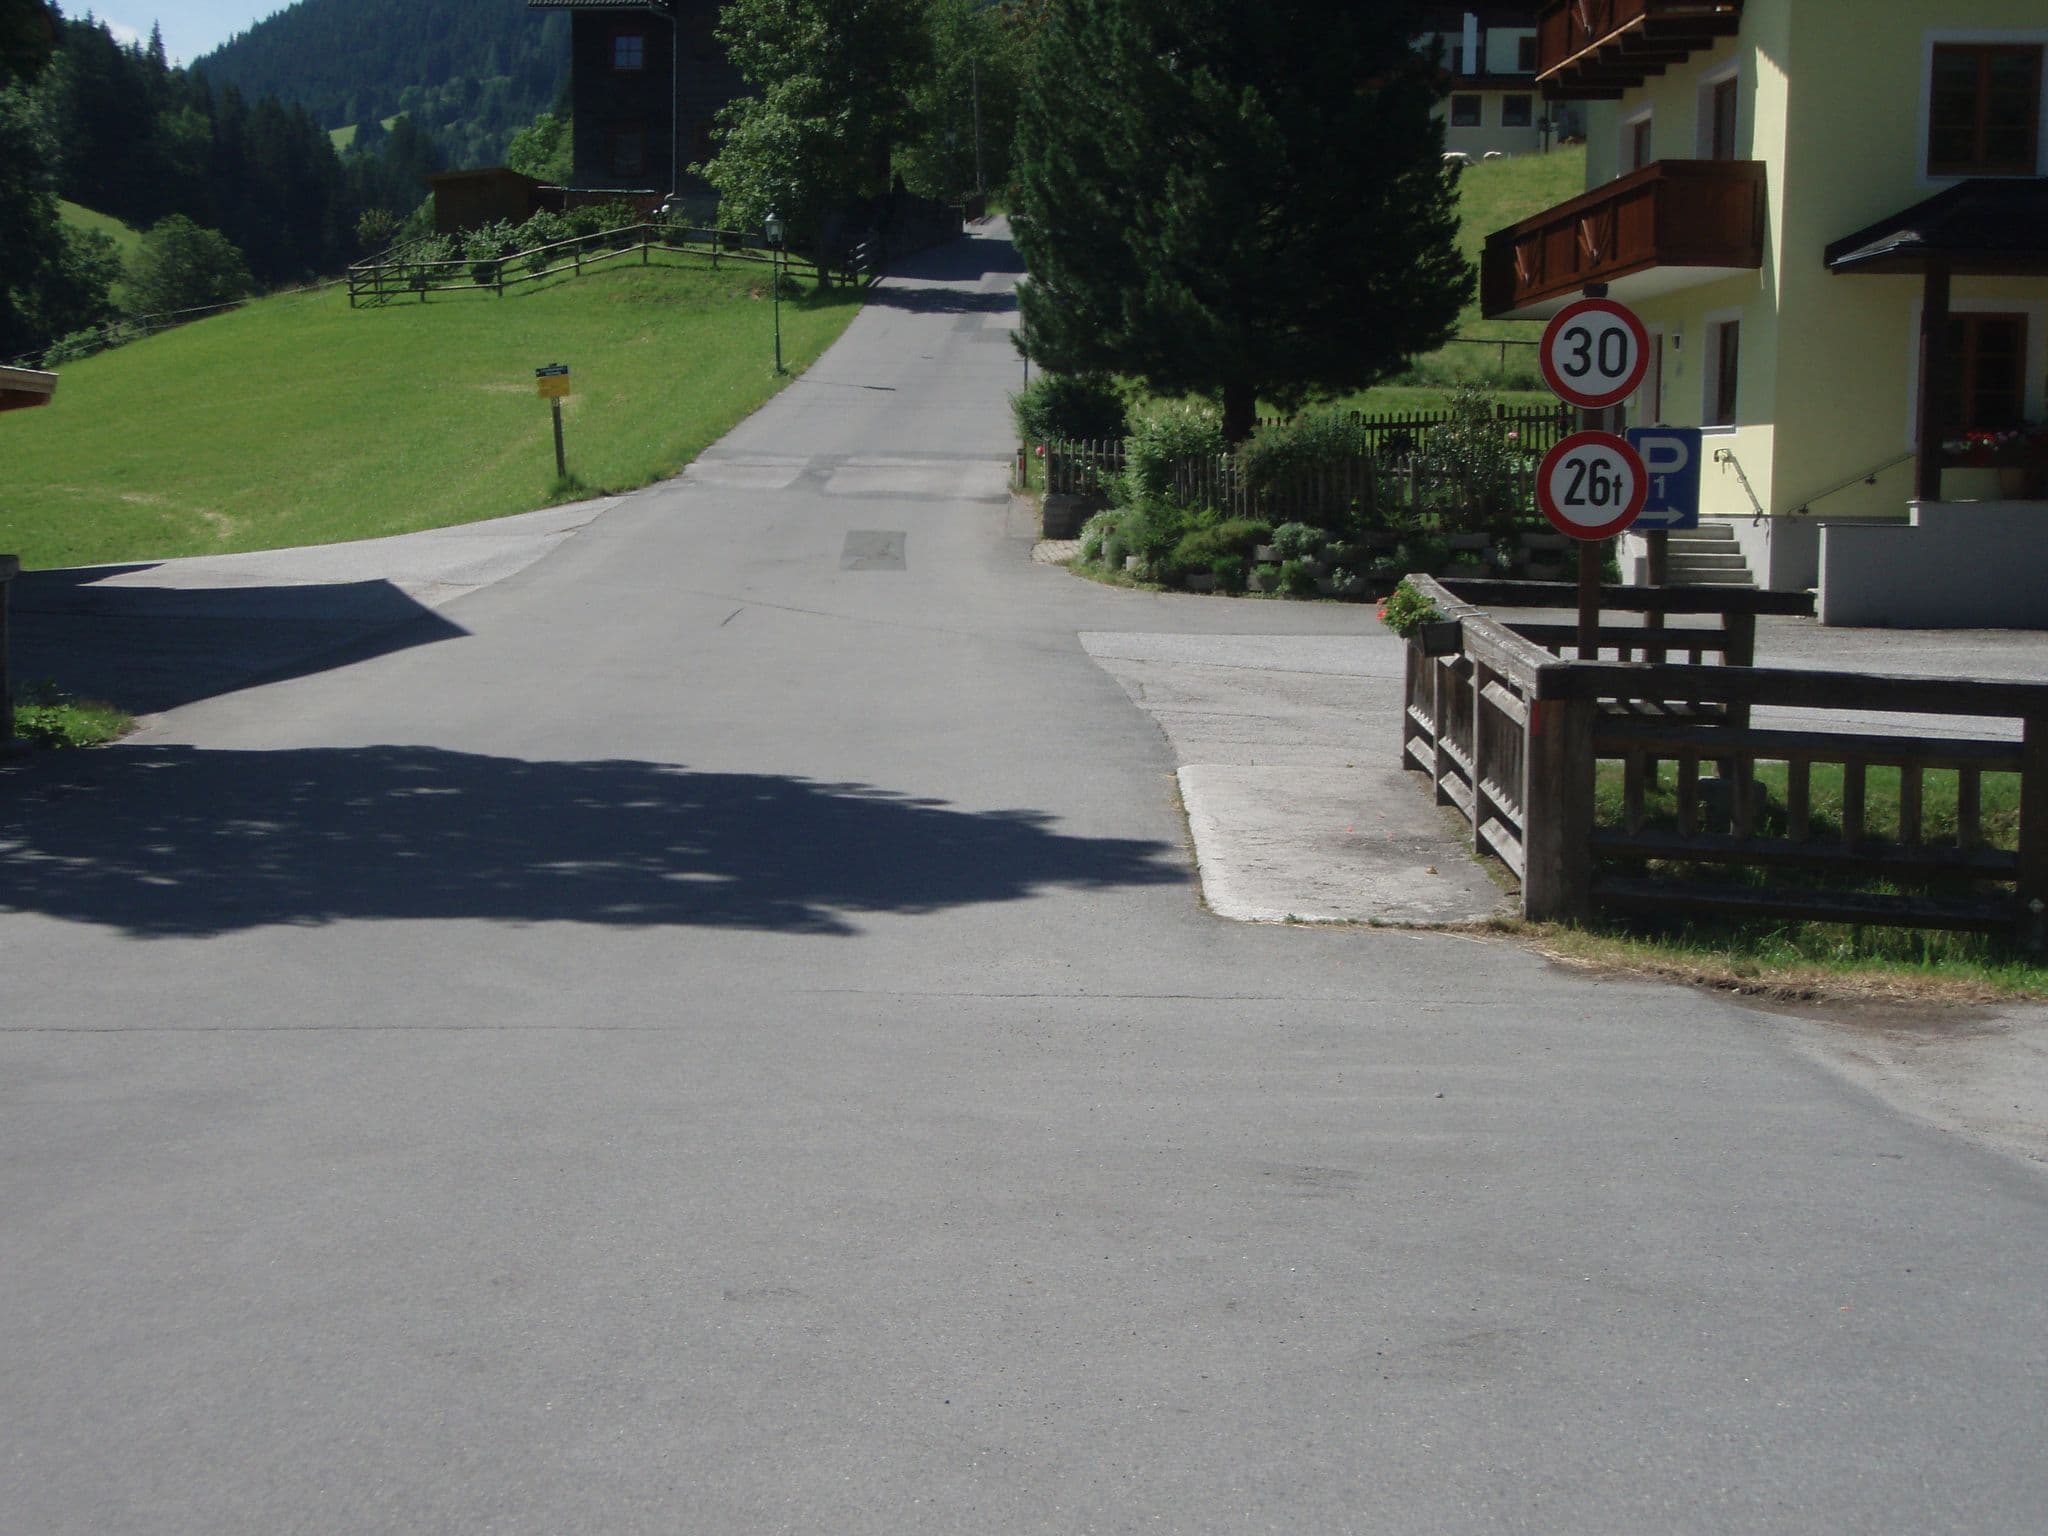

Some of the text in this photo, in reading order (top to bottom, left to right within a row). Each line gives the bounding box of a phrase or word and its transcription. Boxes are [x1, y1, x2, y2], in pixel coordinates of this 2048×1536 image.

[1563, 326, 1628, 378] 30
[1639, 437, 1689, 474] P
[1564, 458, 1623, 507] 26t
[1653, 475, 1666, 499] 1
